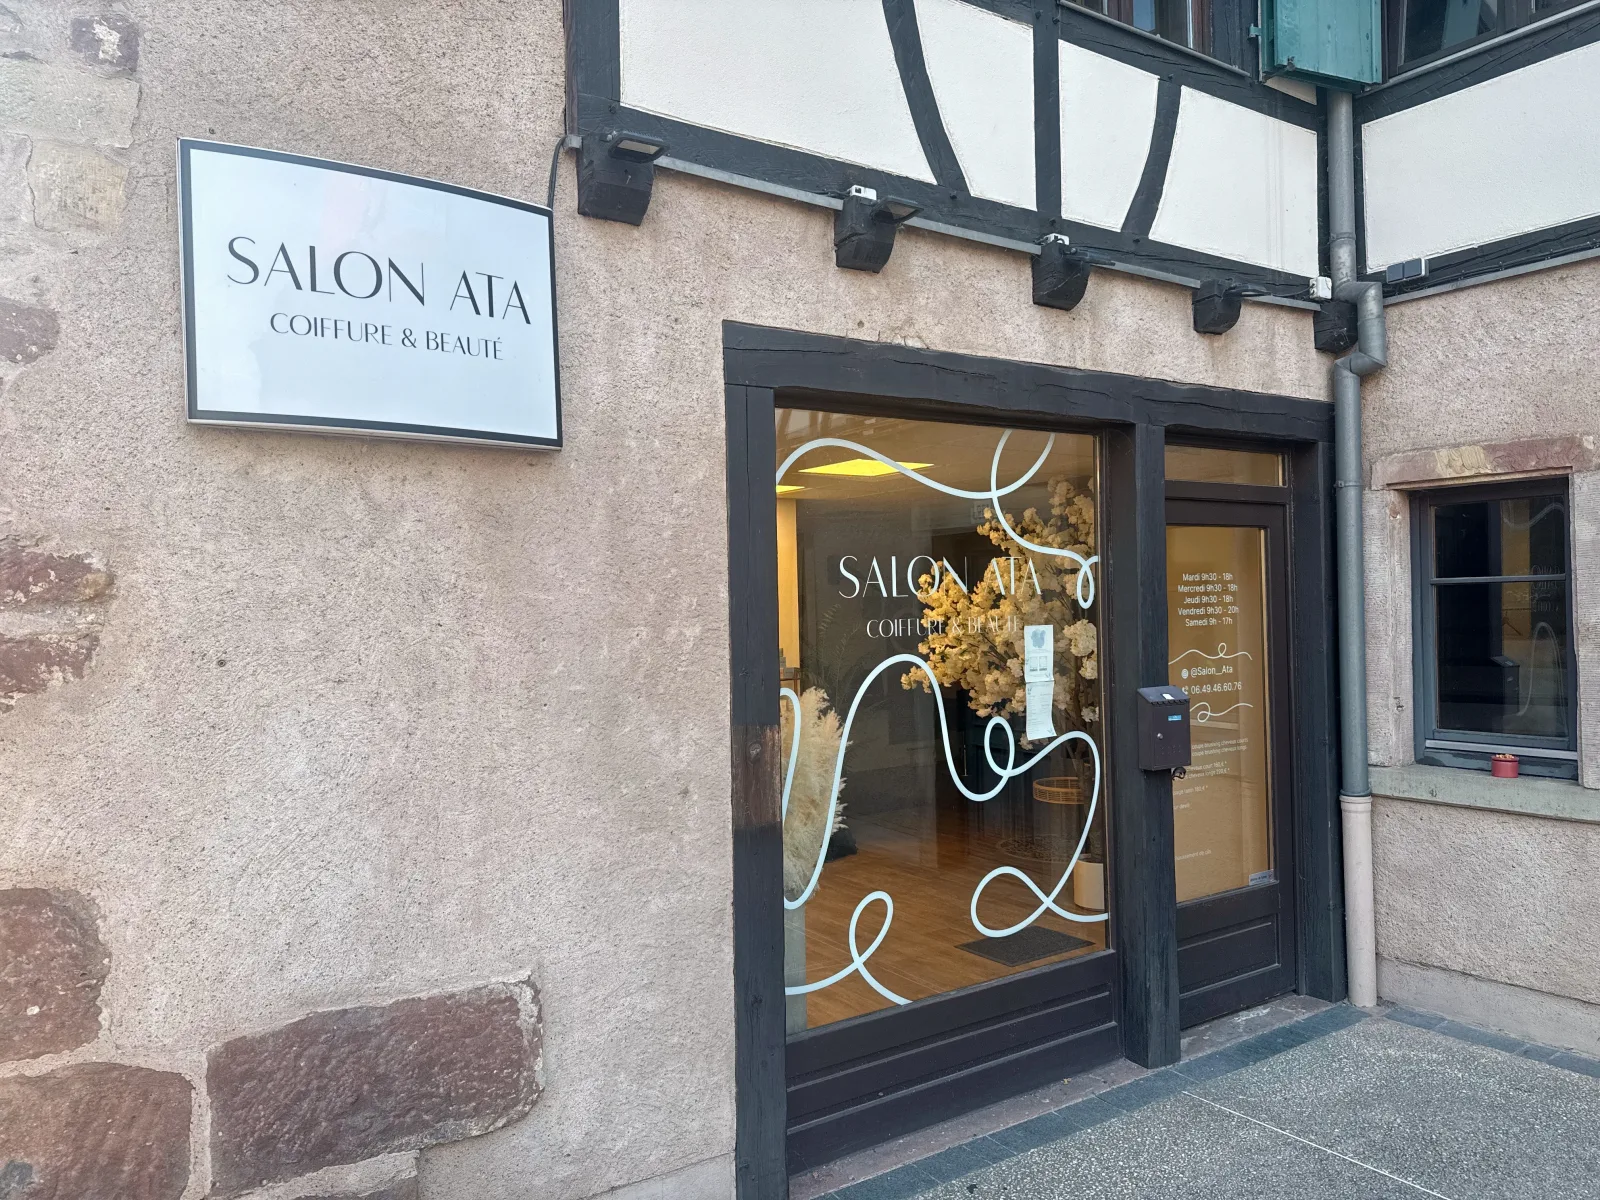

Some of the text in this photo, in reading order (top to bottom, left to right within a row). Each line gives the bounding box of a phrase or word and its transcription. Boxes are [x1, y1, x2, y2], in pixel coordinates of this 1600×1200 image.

[227, 236, 531, 325] SALON ATA
[270, 312, 504, 360] COIFFURE & BEAUTÉ
[838, 555, 1042, 599] SALON ATA
[1182, 573, 1200, 581] Mardi
[1201, 572, 1217, 581] 9h30
[1222, 572, 1233, 580] 18h
[1178, 584, 1205, 592] Mercredi
[1206, 583, 1222, 592] 9h30
[1227, 583, 1238, 591] 18h
[1183, 596, 1200, 604] Jeudi
[1201, 595, 1217, 603] 9h30
[1178, 607, 1205, 615] Vendredi
[1206, 606, 1222, 614] 9h30
[1227, 605, 1239, 614] 20h
[866, 618, 946, 638] COIFFURE
[952, 616, 965, 635] &
[1185, 618, 1208, 627] Samedi
[1208, 617, 1217, 625] 9h
[1222, 617, 1233, 625] 17h
